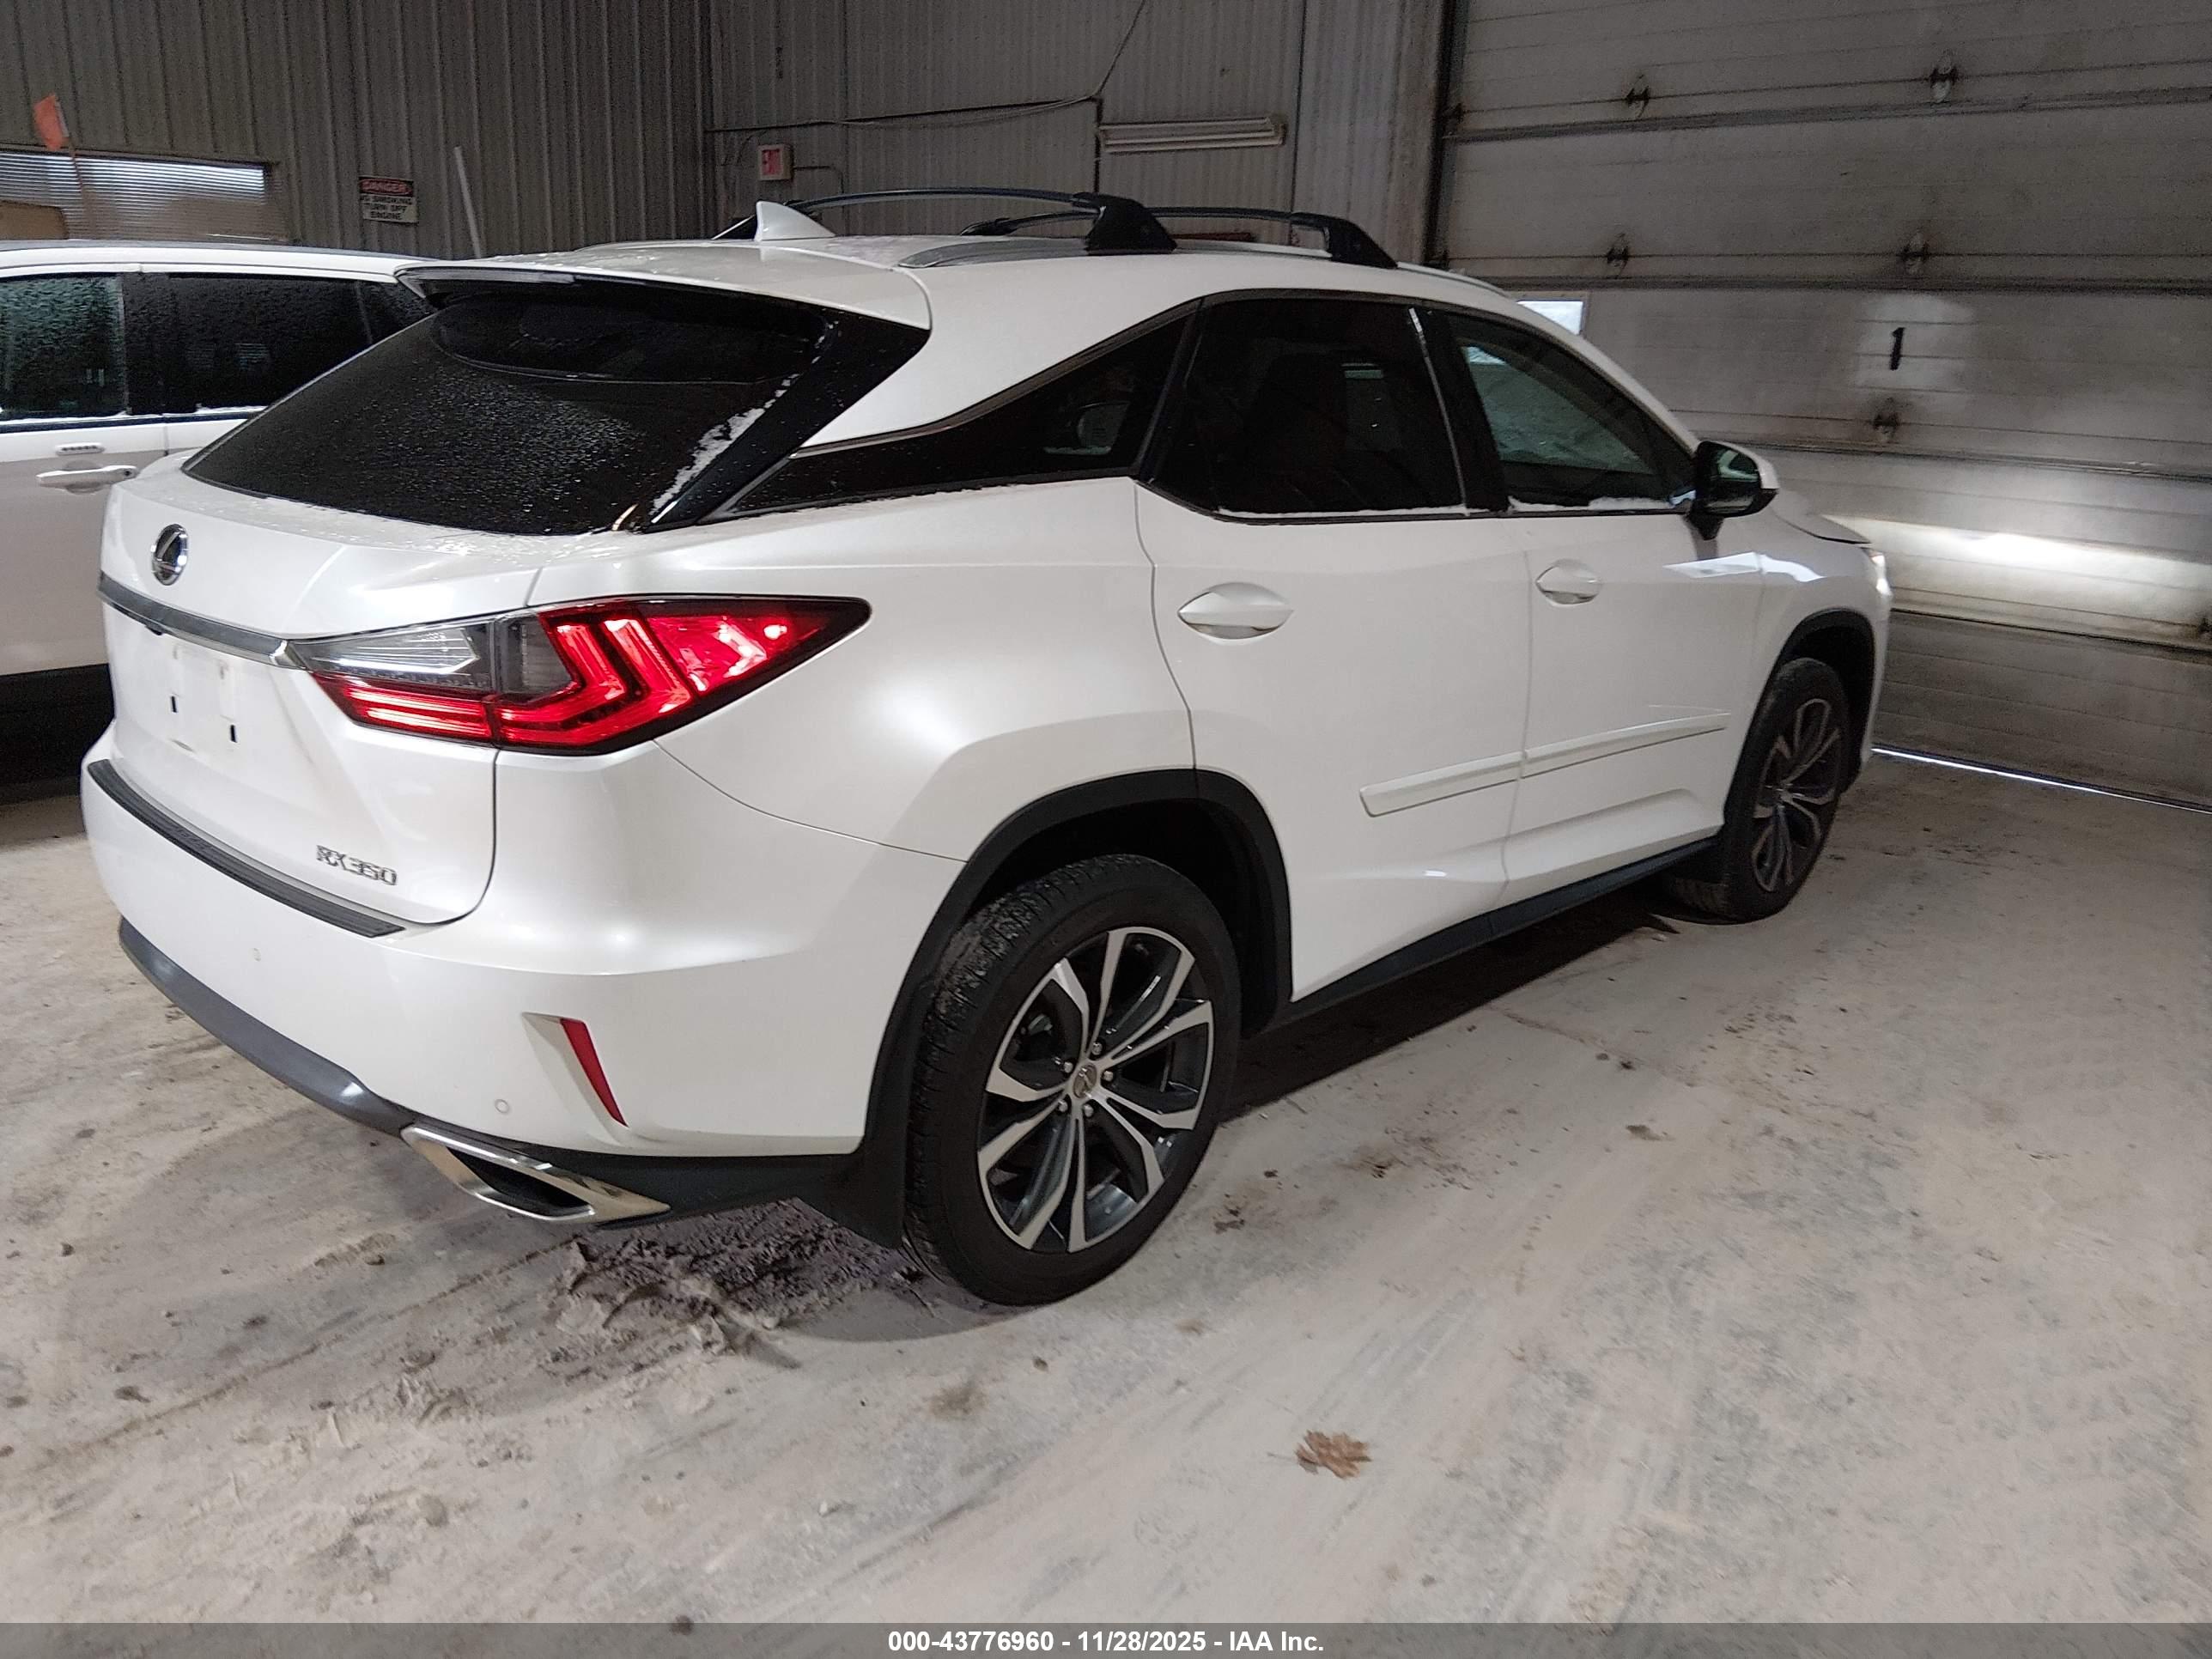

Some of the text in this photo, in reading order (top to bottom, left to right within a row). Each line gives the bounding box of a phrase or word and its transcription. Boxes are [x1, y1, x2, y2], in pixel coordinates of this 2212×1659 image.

[361, 181, 408, 194] DANGER
[372, 197, 412, 205] SMOKING
[370, 211, 401, 220] ENGINE
[1890, 327, 1905, 371] 1
